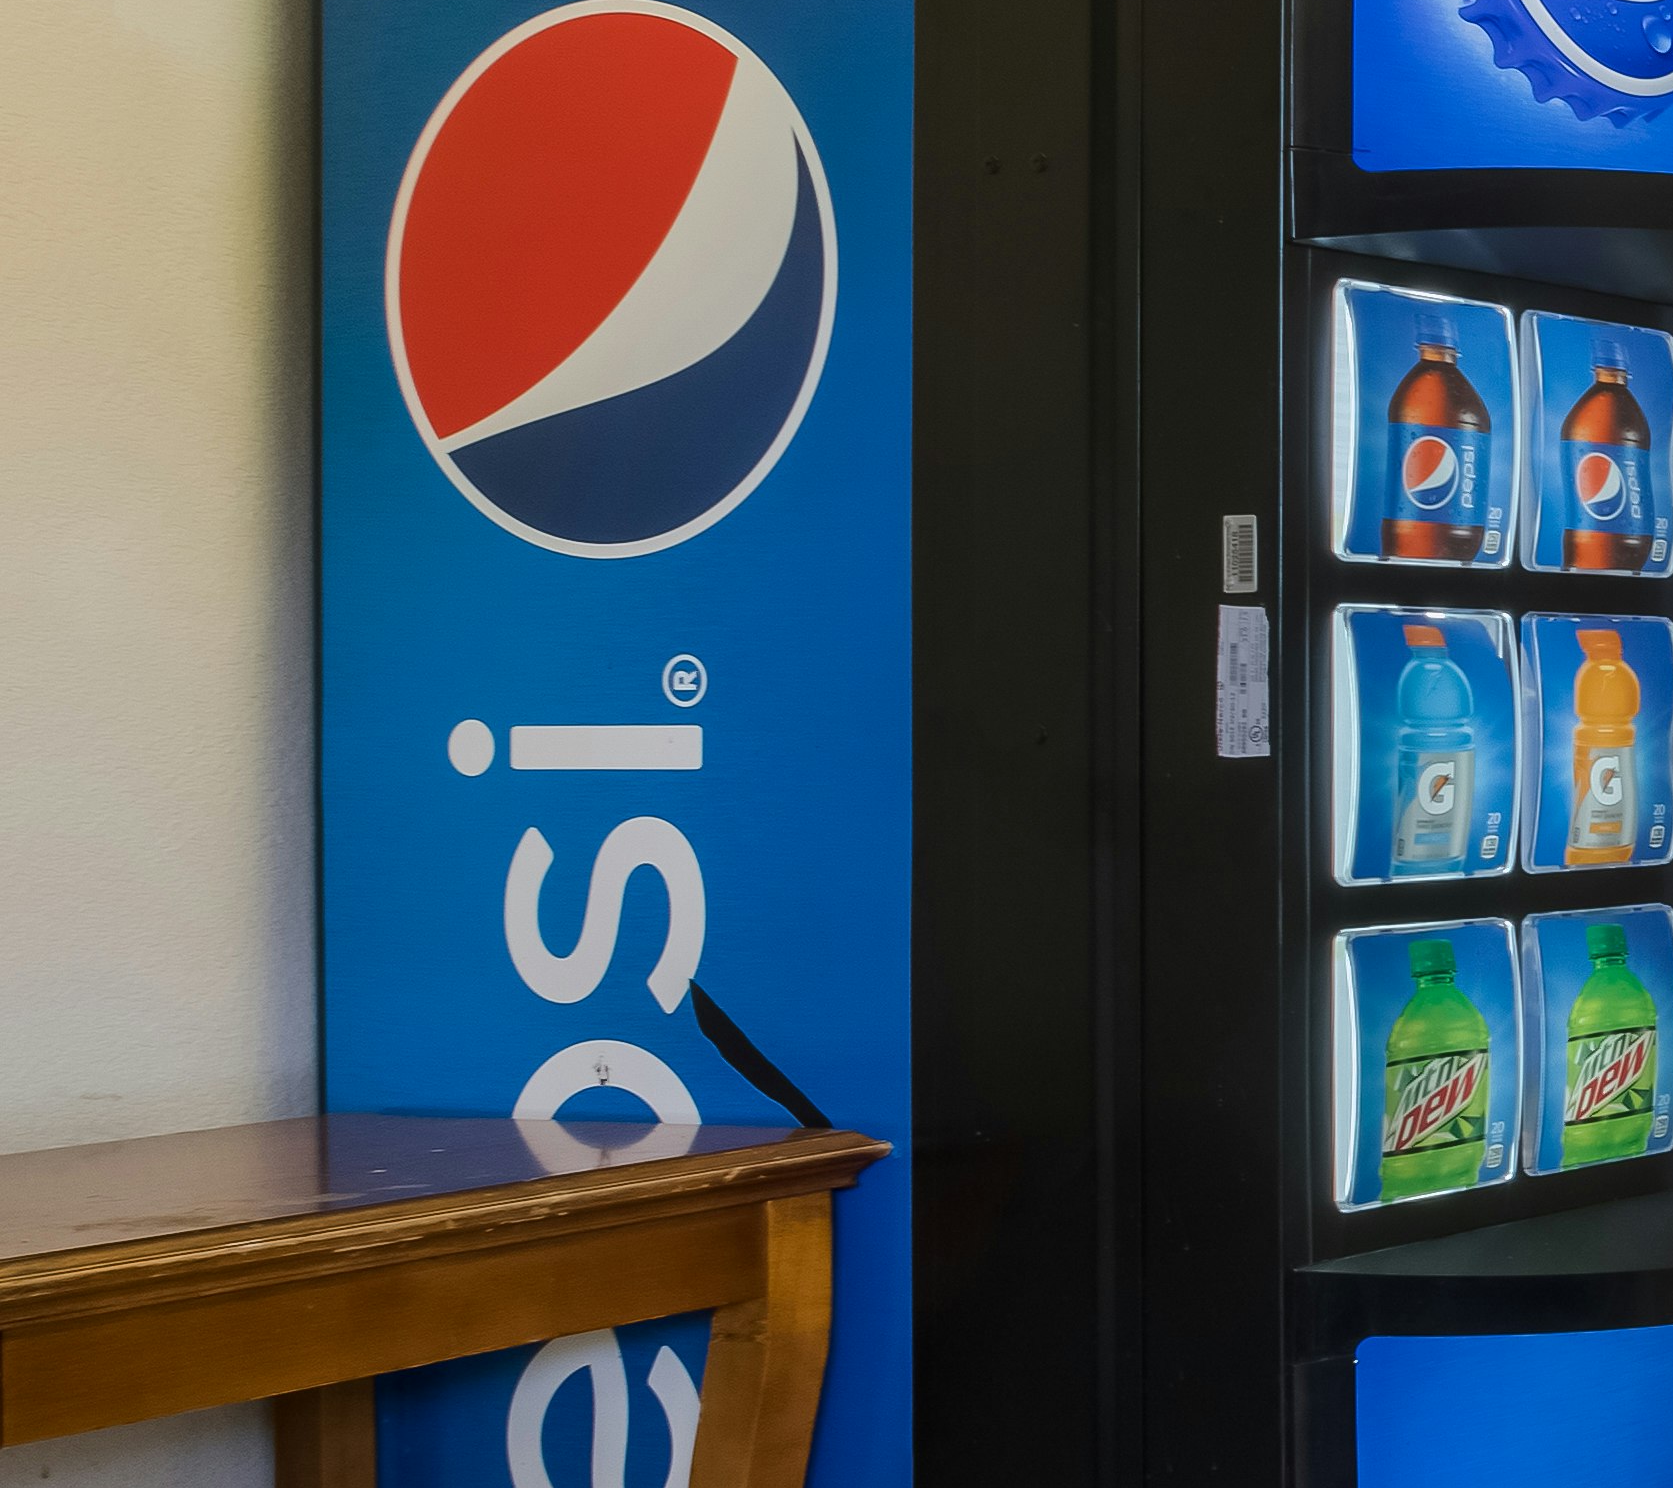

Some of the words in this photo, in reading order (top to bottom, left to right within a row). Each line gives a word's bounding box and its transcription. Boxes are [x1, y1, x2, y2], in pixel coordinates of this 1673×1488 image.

[1462, 444, 1475, 509] pepsi
[1622, 459, 1643, 519] pepsi
[1417, 760, 1455, 815] G
[1590, 756, 1624, 806] G
